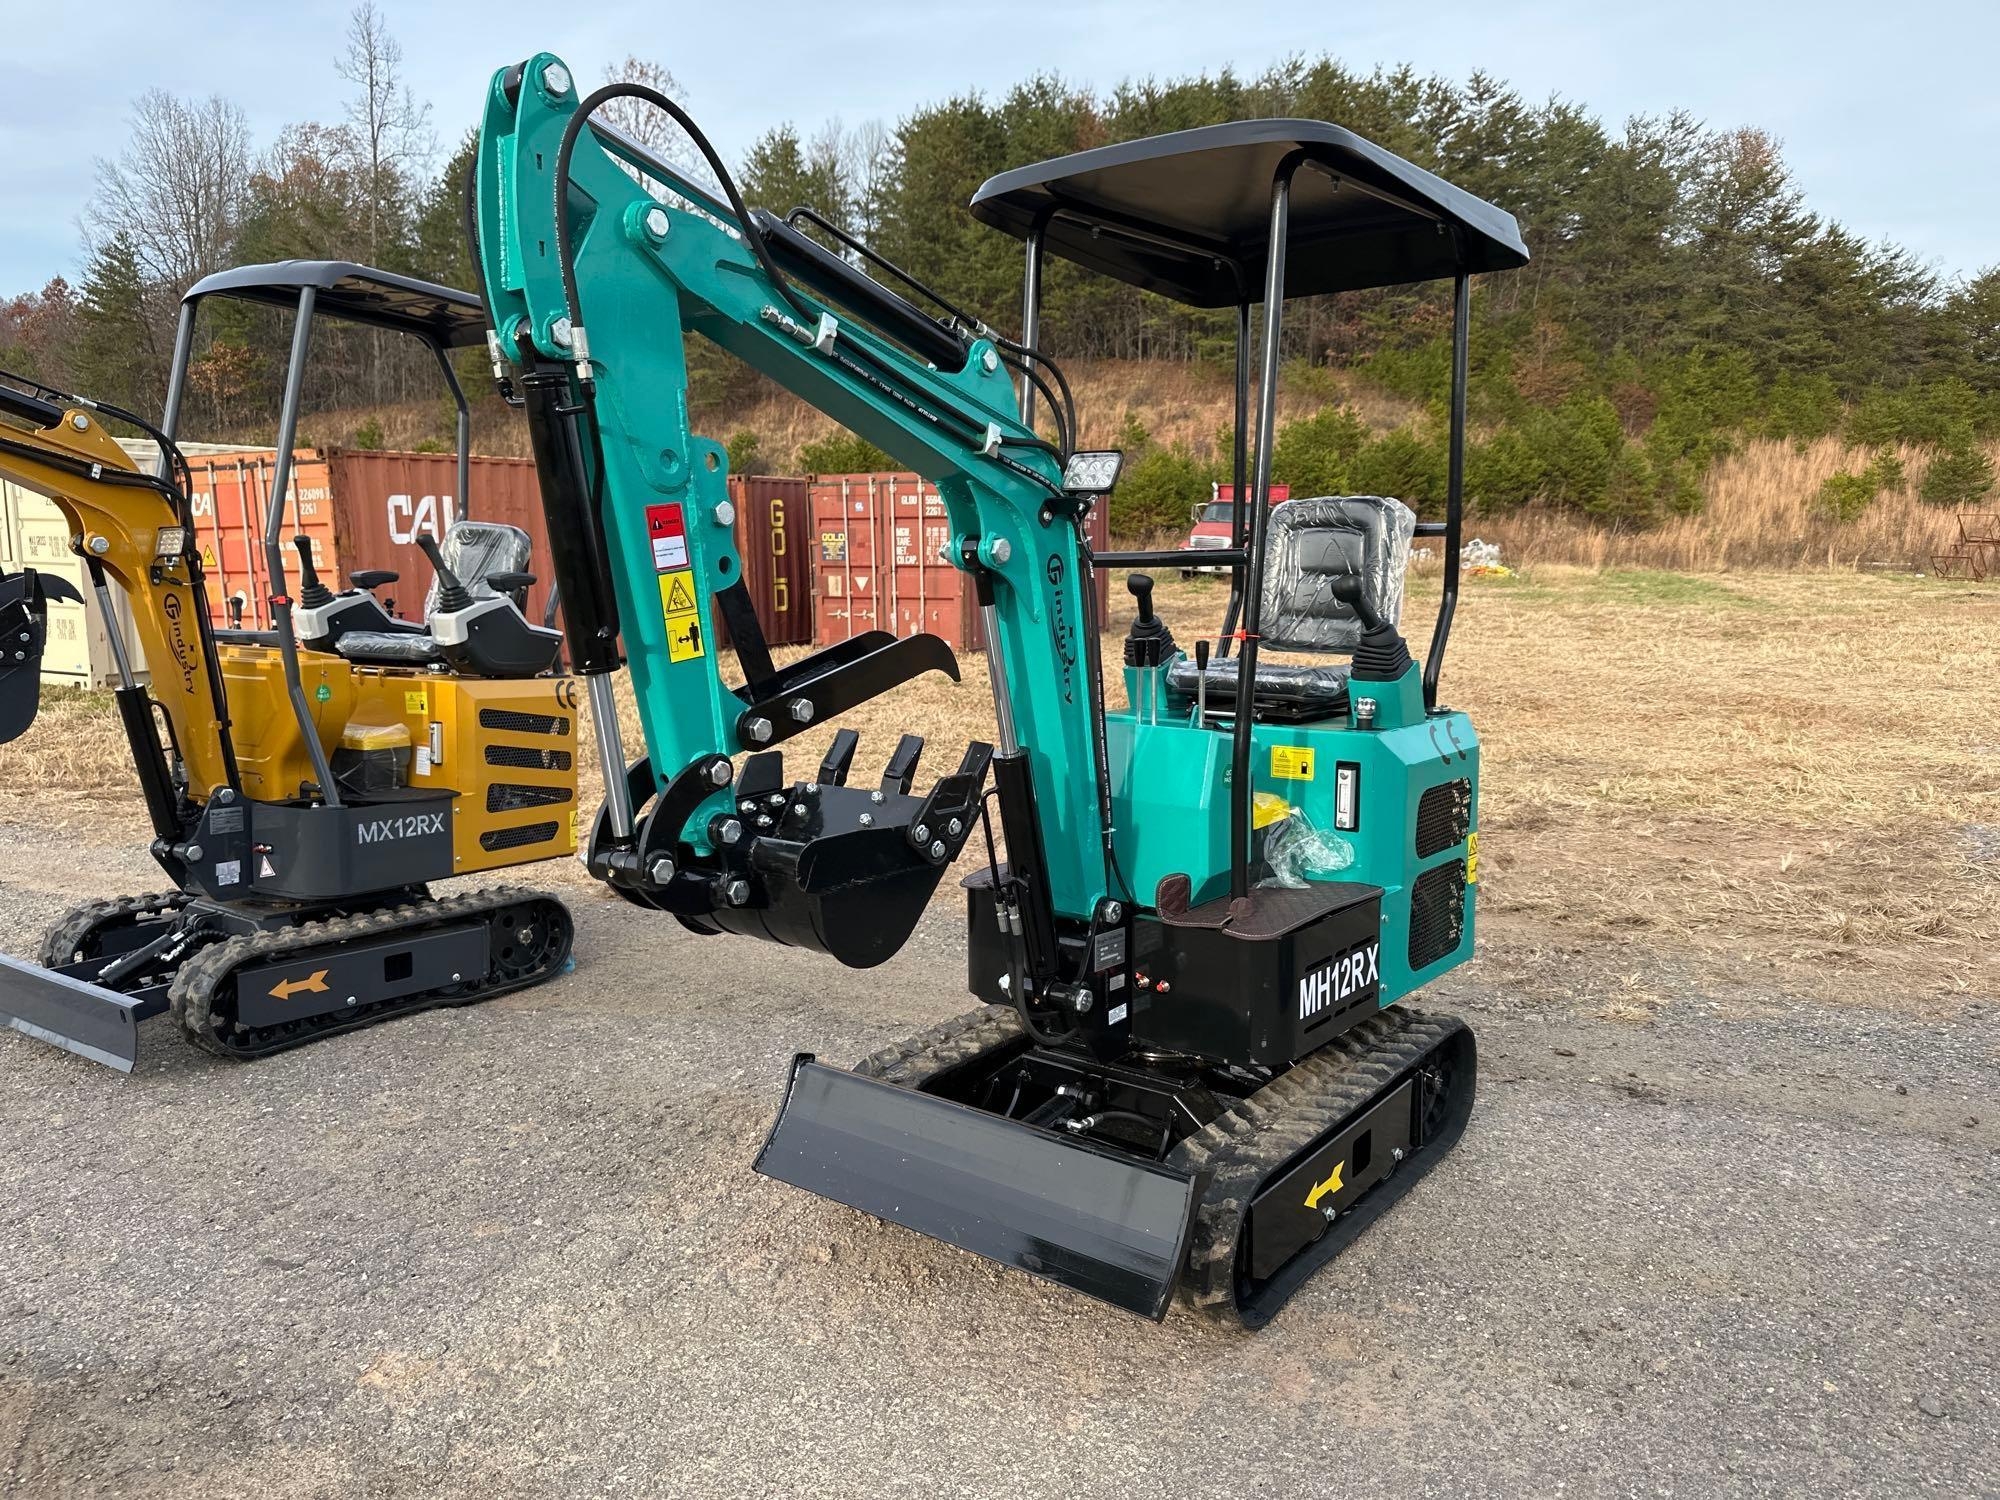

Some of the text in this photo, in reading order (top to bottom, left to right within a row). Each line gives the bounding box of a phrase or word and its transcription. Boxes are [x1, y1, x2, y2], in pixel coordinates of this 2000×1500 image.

[770, 499, 788, 612] GOLD
[821, 533, 845, 542] GOLD
[358, 812, 445, 846] MX12RX
[1300, 942, 1380, 1020] MH12RX
